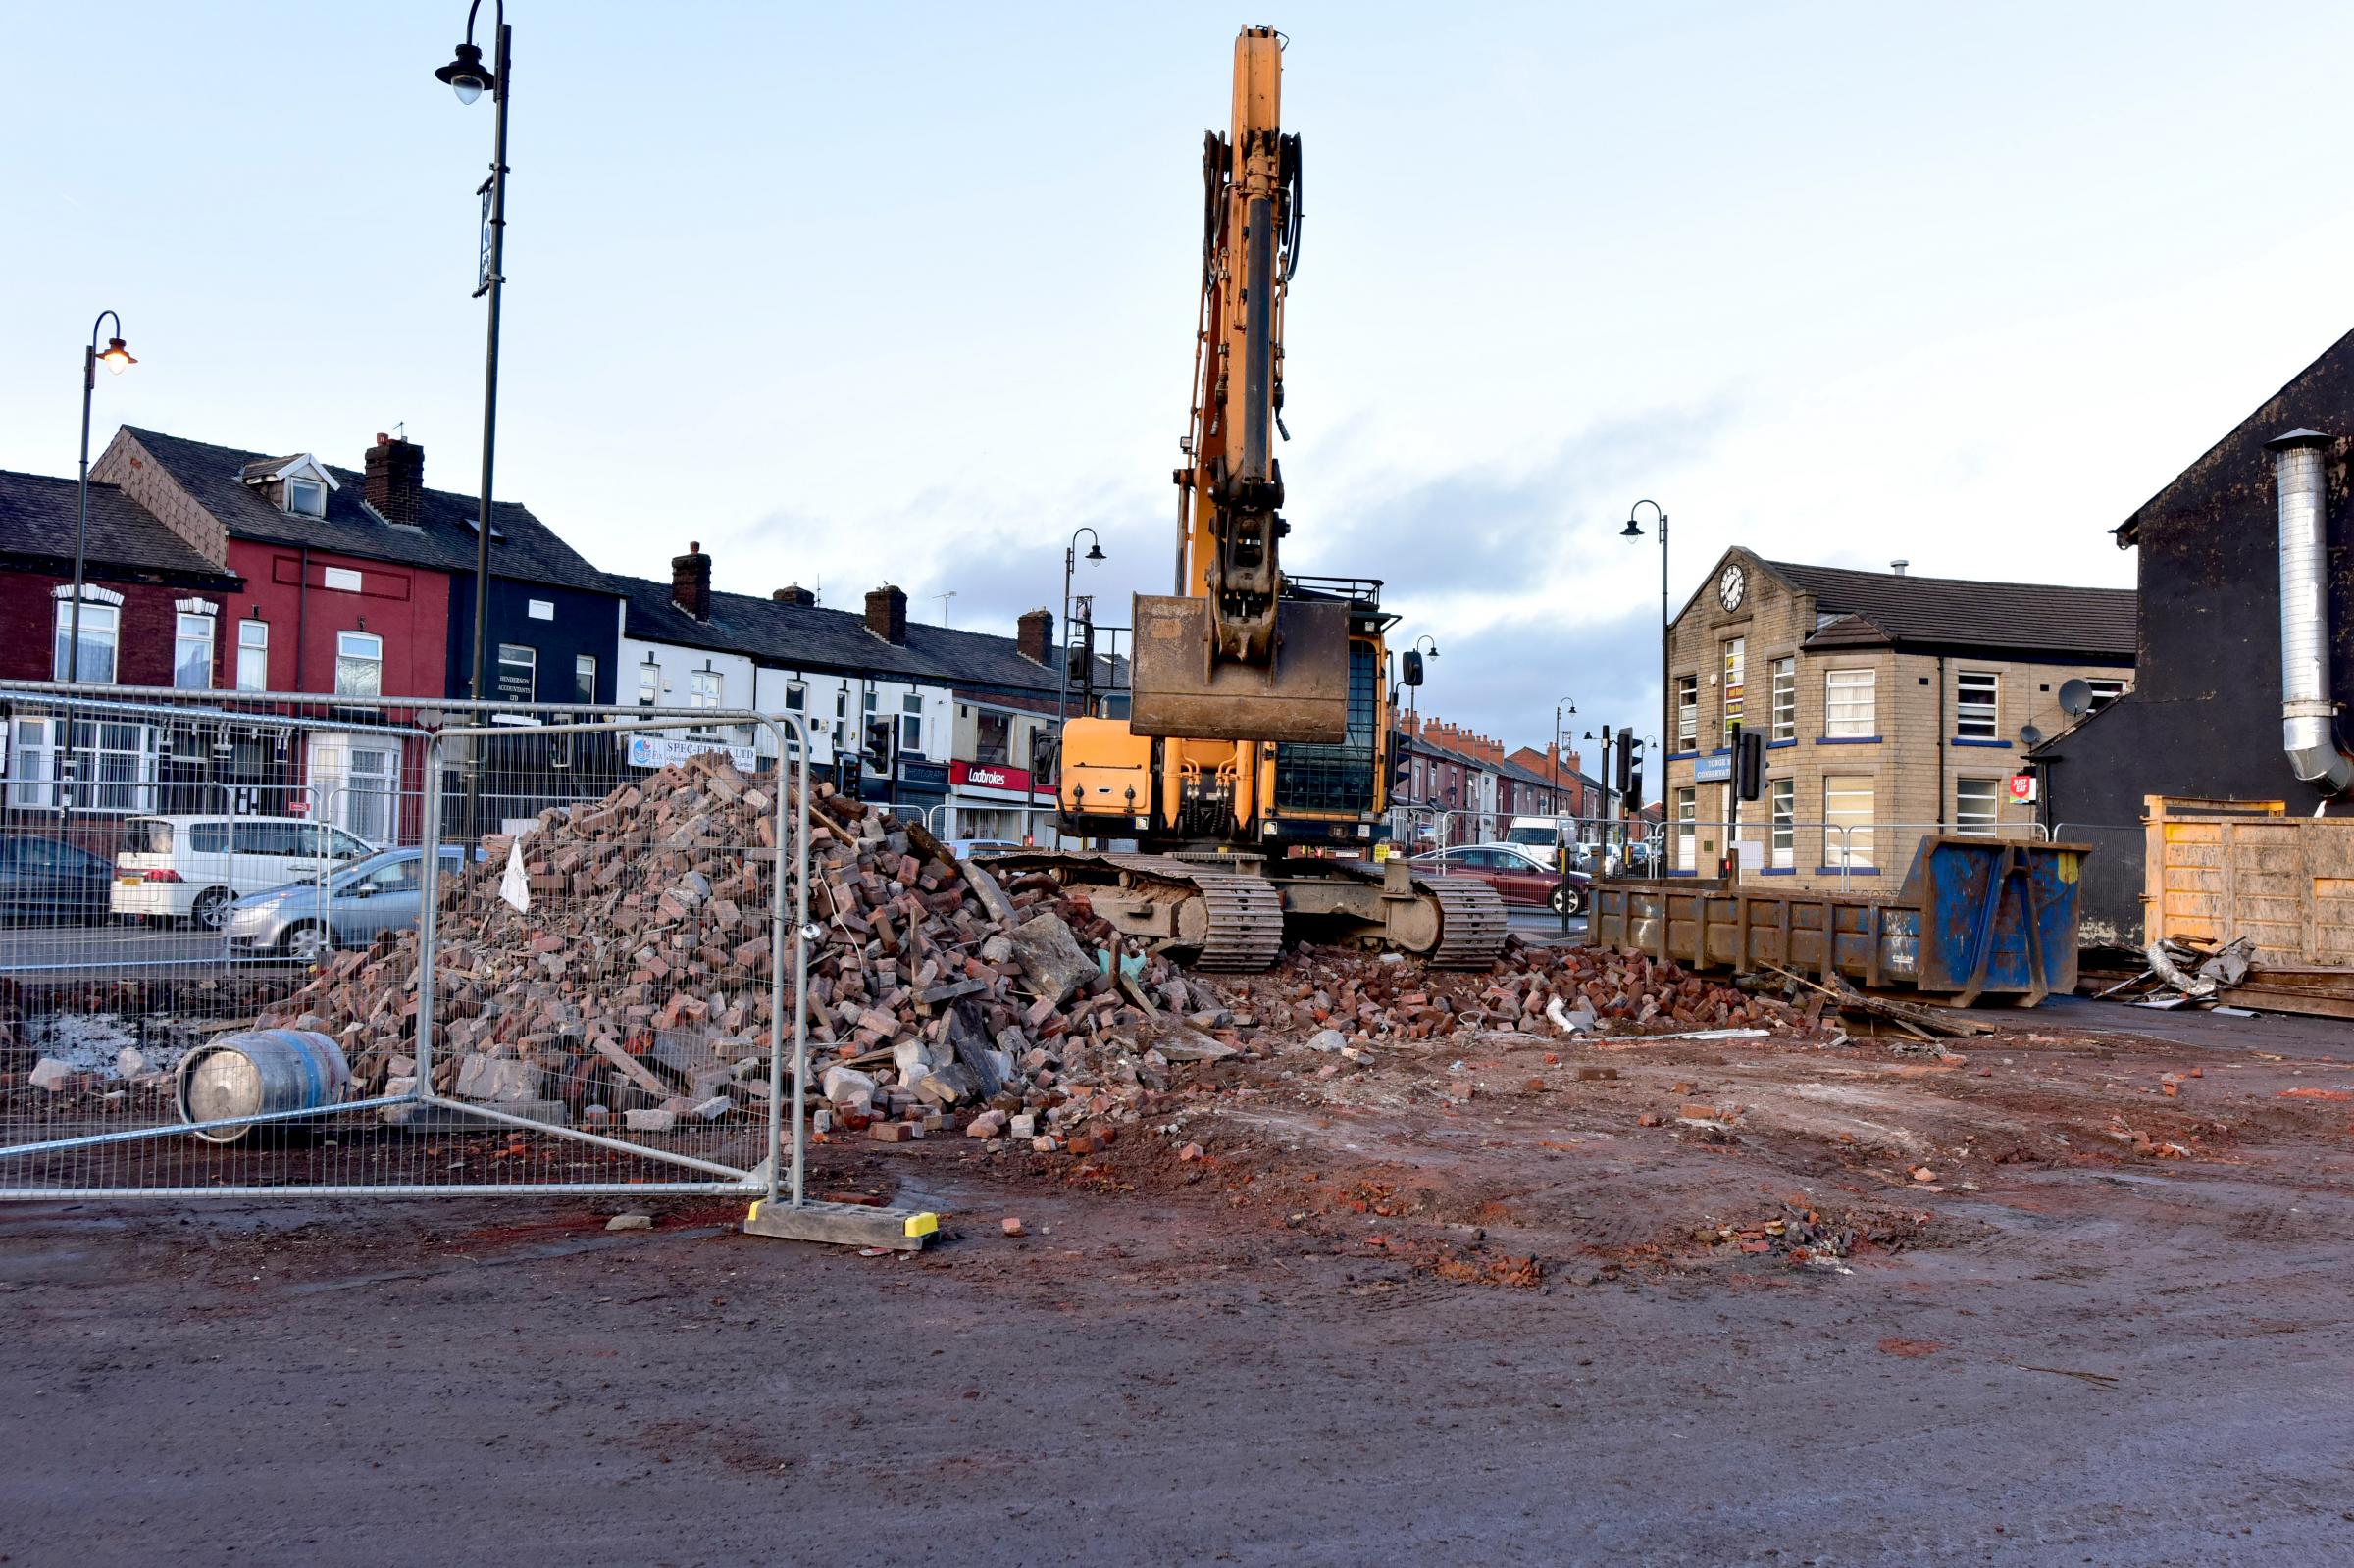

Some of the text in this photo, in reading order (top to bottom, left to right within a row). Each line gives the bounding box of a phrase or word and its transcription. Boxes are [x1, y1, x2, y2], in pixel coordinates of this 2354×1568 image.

[499, 675, 530, 684] HENDERSON
[498, 684, 532, 693] ACCOUNTANTS
[735, 748, 754, 759] LTD
[968, 768, 1005, 784] Ladbrokes
[2013, 778, 2027, 786] JUST
